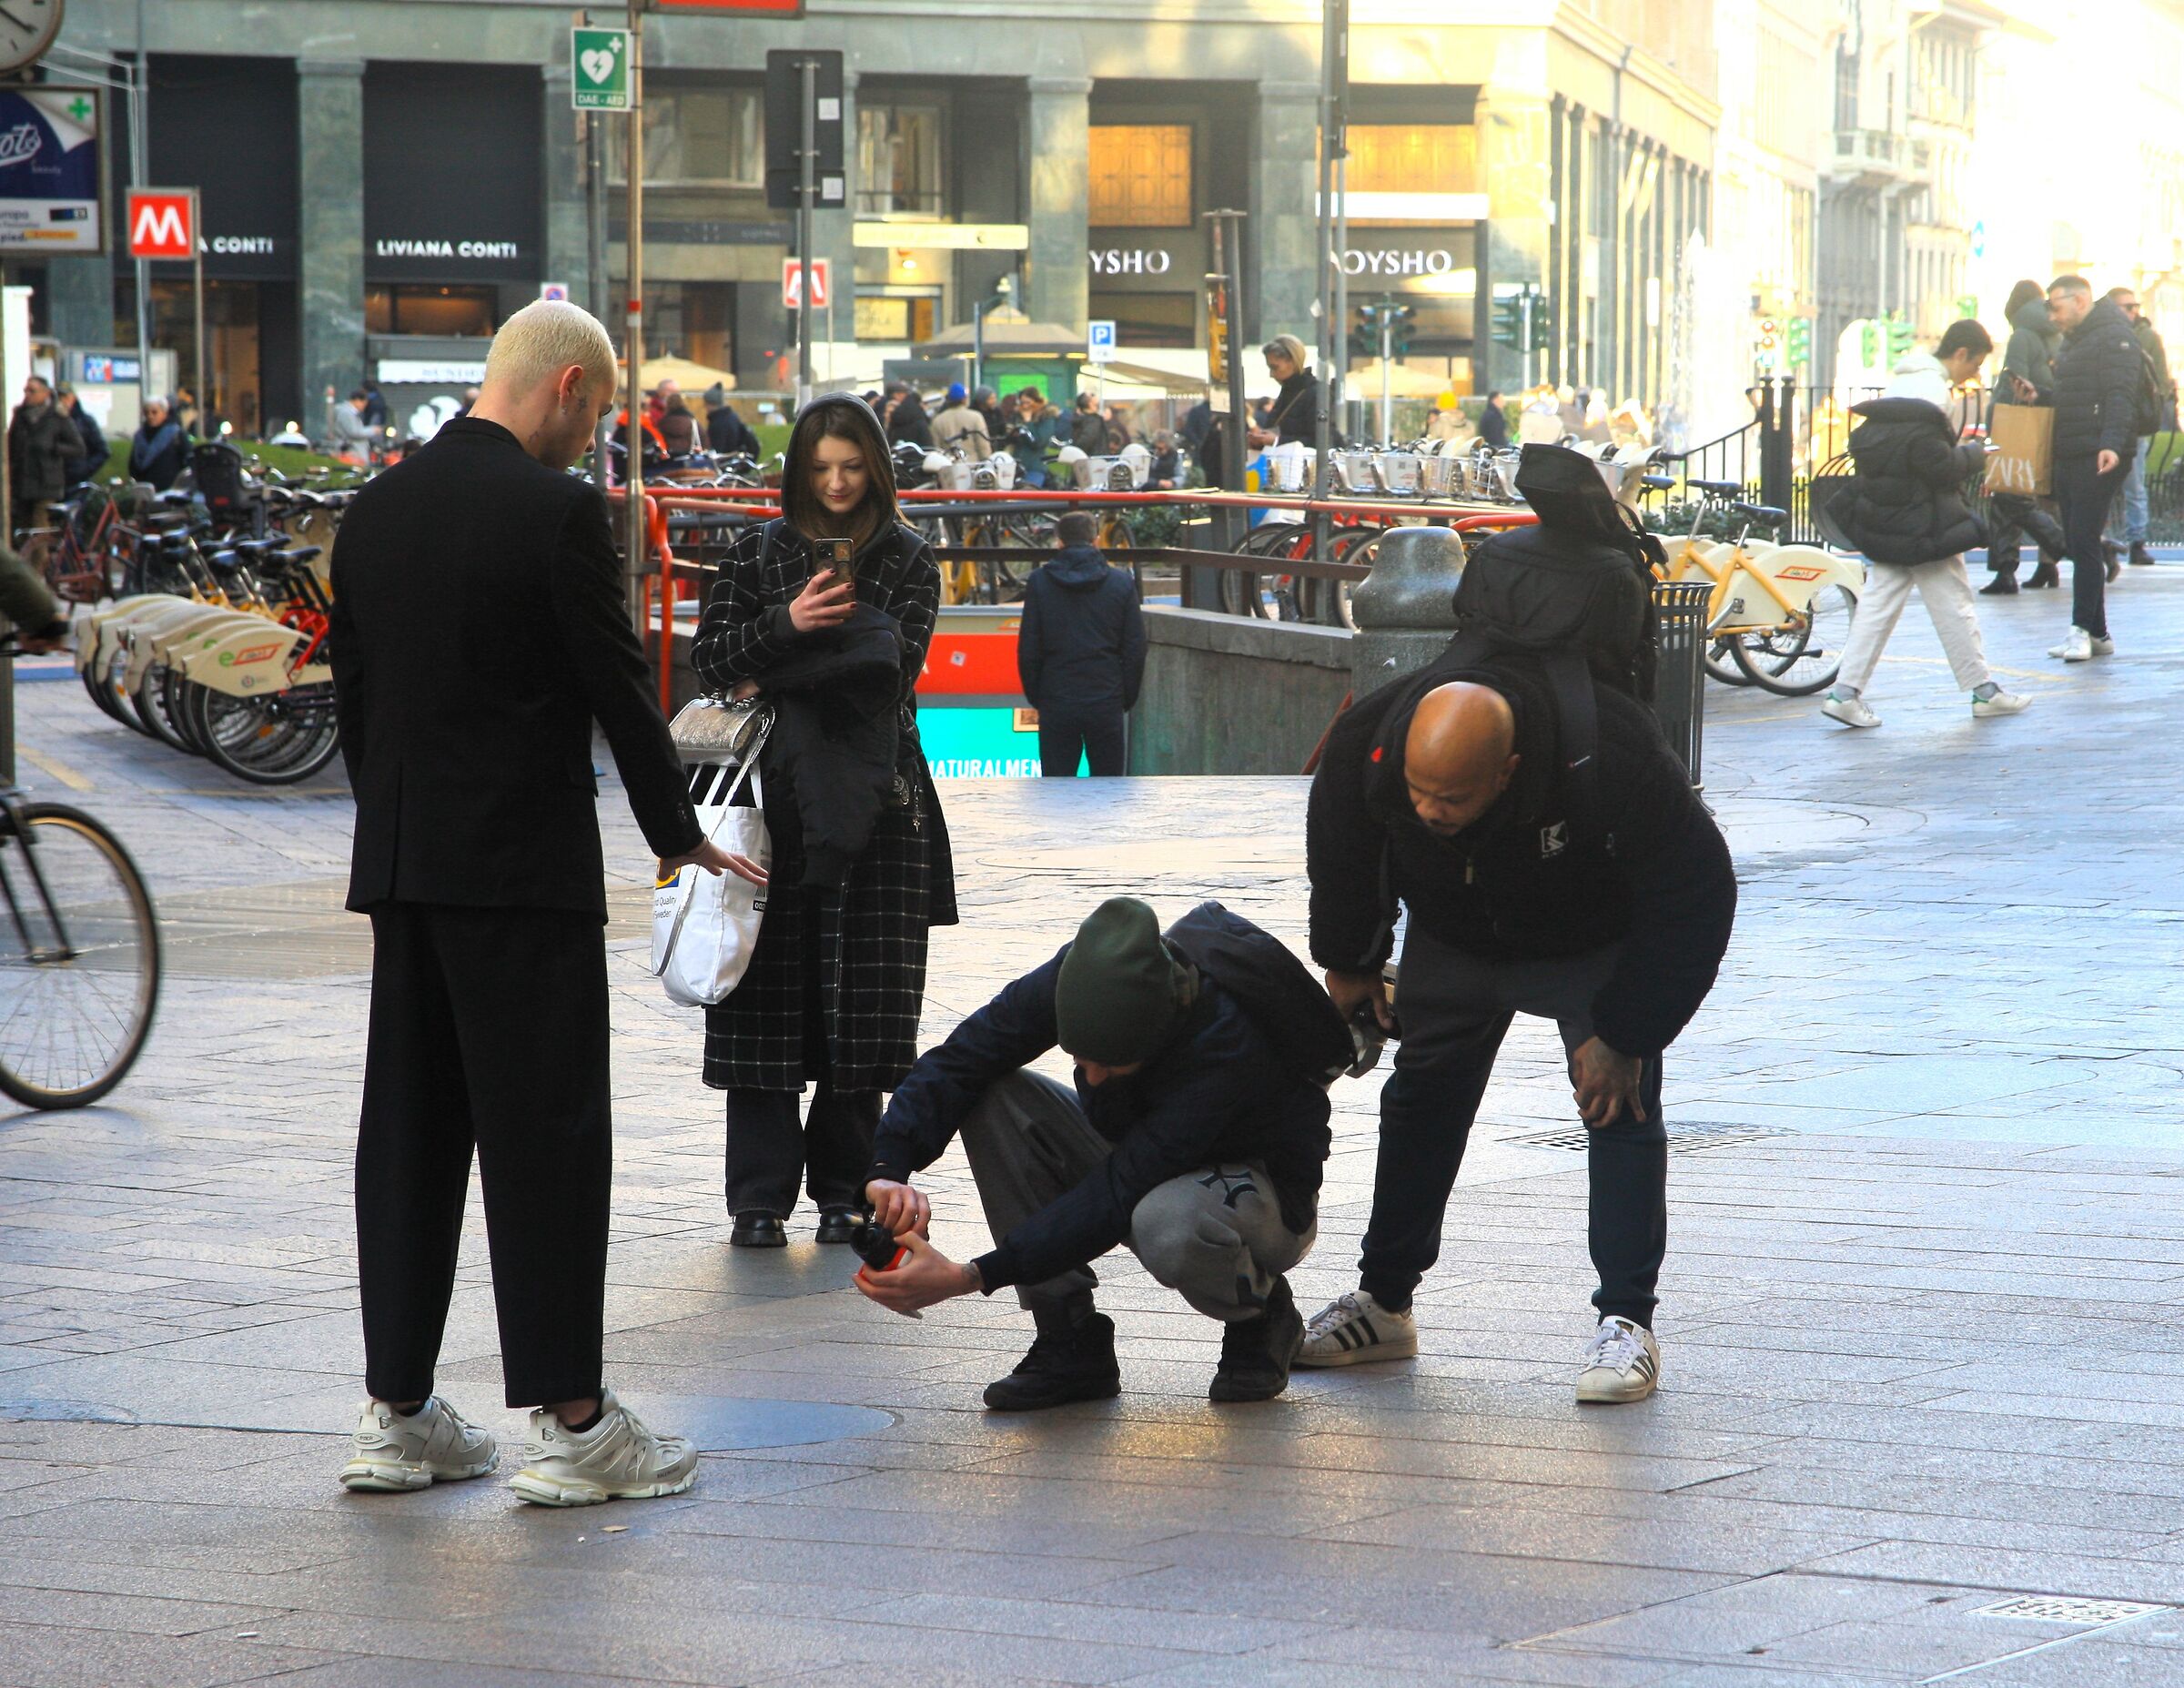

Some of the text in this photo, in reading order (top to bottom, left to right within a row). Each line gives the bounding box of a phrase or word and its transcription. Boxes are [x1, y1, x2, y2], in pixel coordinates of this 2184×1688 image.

[578, 94, 598, 104] DAE
[606, 95, 625, 106] AED
[133, 205, 187, 246] M
[212, 237, 273, 254] CONTI
[376, 239, 517, 258] LIVIANA CONTI
[1088, 248, 1170, 274] YSHO
[1095, 328, 1108, 344] P
